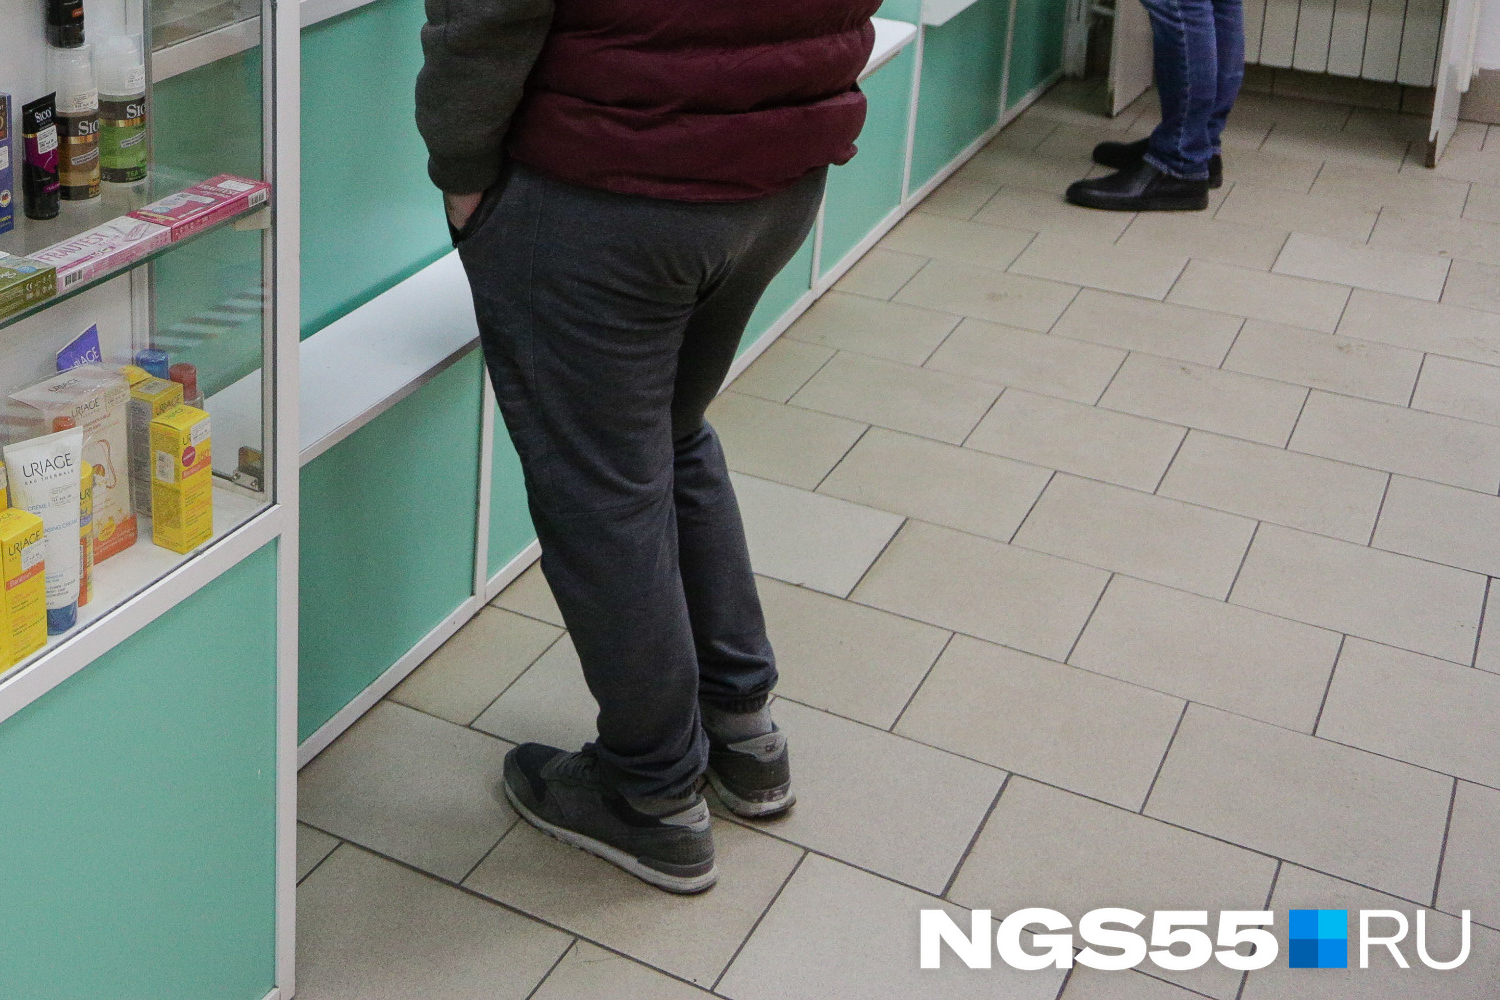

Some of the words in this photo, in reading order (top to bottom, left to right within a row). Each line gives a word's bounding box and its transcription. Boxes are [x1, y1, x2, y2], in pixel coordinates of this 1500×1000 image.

[40, 231, 111, 262] FRAUTEST
[71, 397, 100, 418] URIAGE
[22, 452, 73, 478] URIAGE
